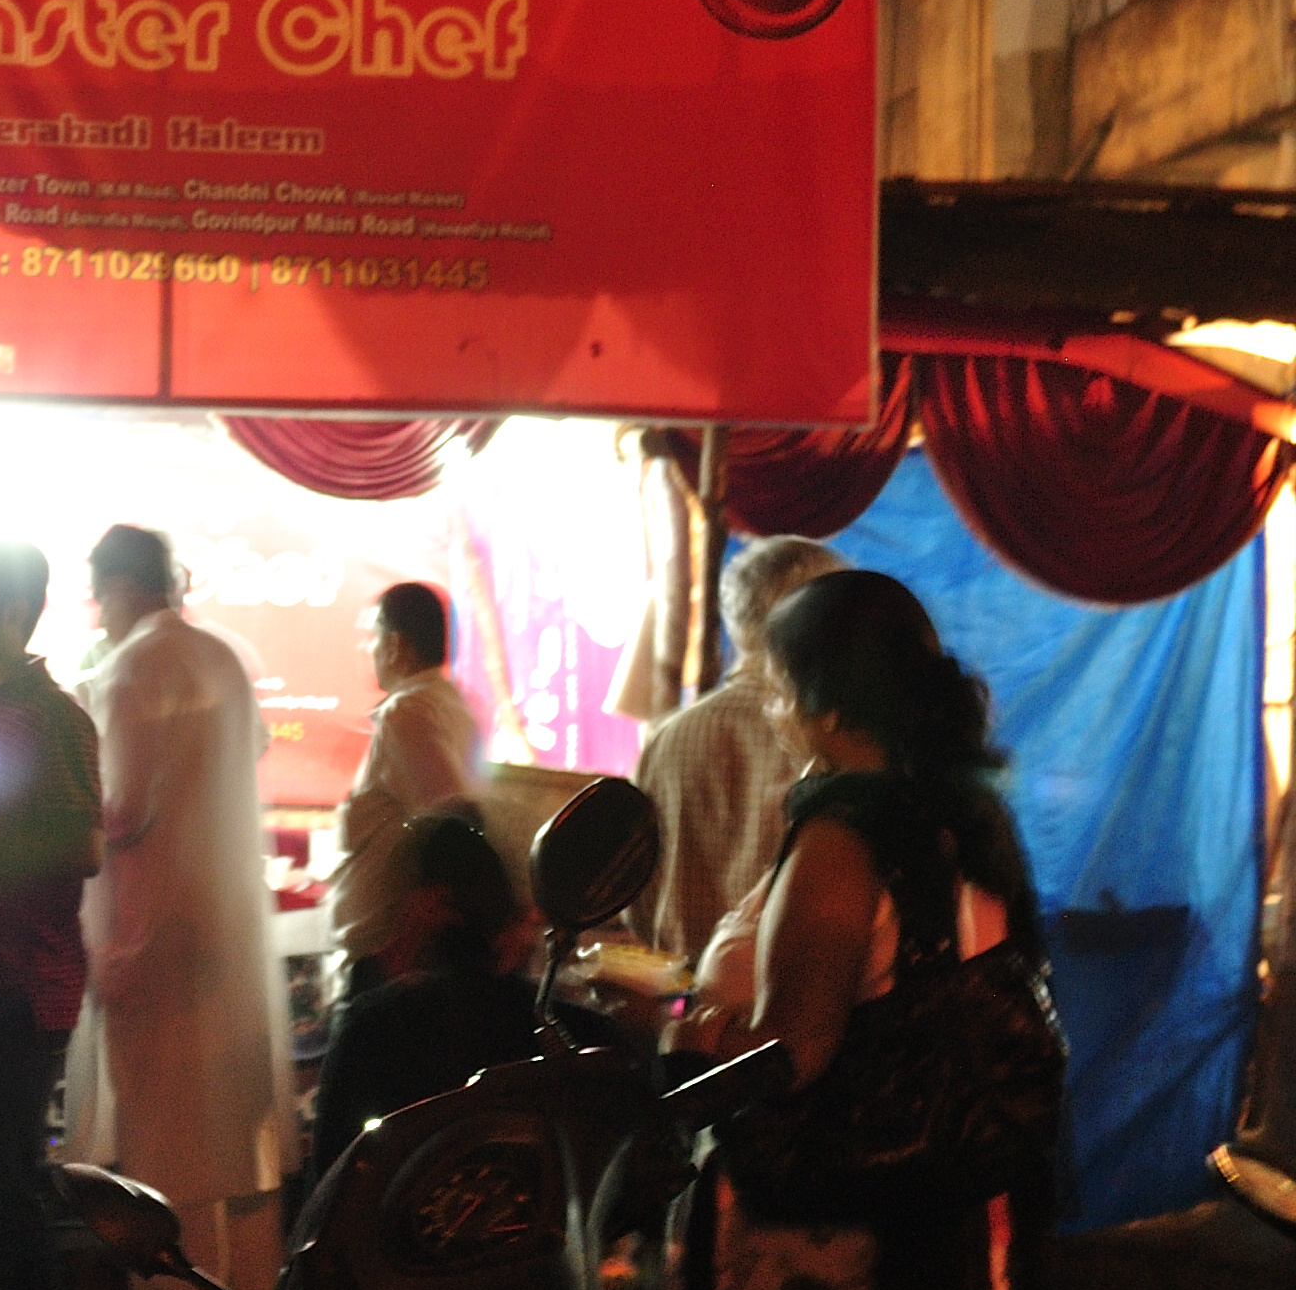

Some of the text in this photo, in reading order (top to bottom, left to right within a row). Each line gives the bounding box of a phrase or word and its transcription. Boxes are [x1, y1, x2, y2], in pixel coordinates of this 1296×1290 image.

[167, 115, 323, 154] Haleem
[34, 173, 91, 196] Town
[183, 179, 269, 202] Chandni
[275, 180, 347, 204] Chowk
[5, 203, 59, 224] Road
[192, 209, 299, 235] Govindpur
[305, 212, 355, 234] Main
[360, 213, 416, 235] Road
